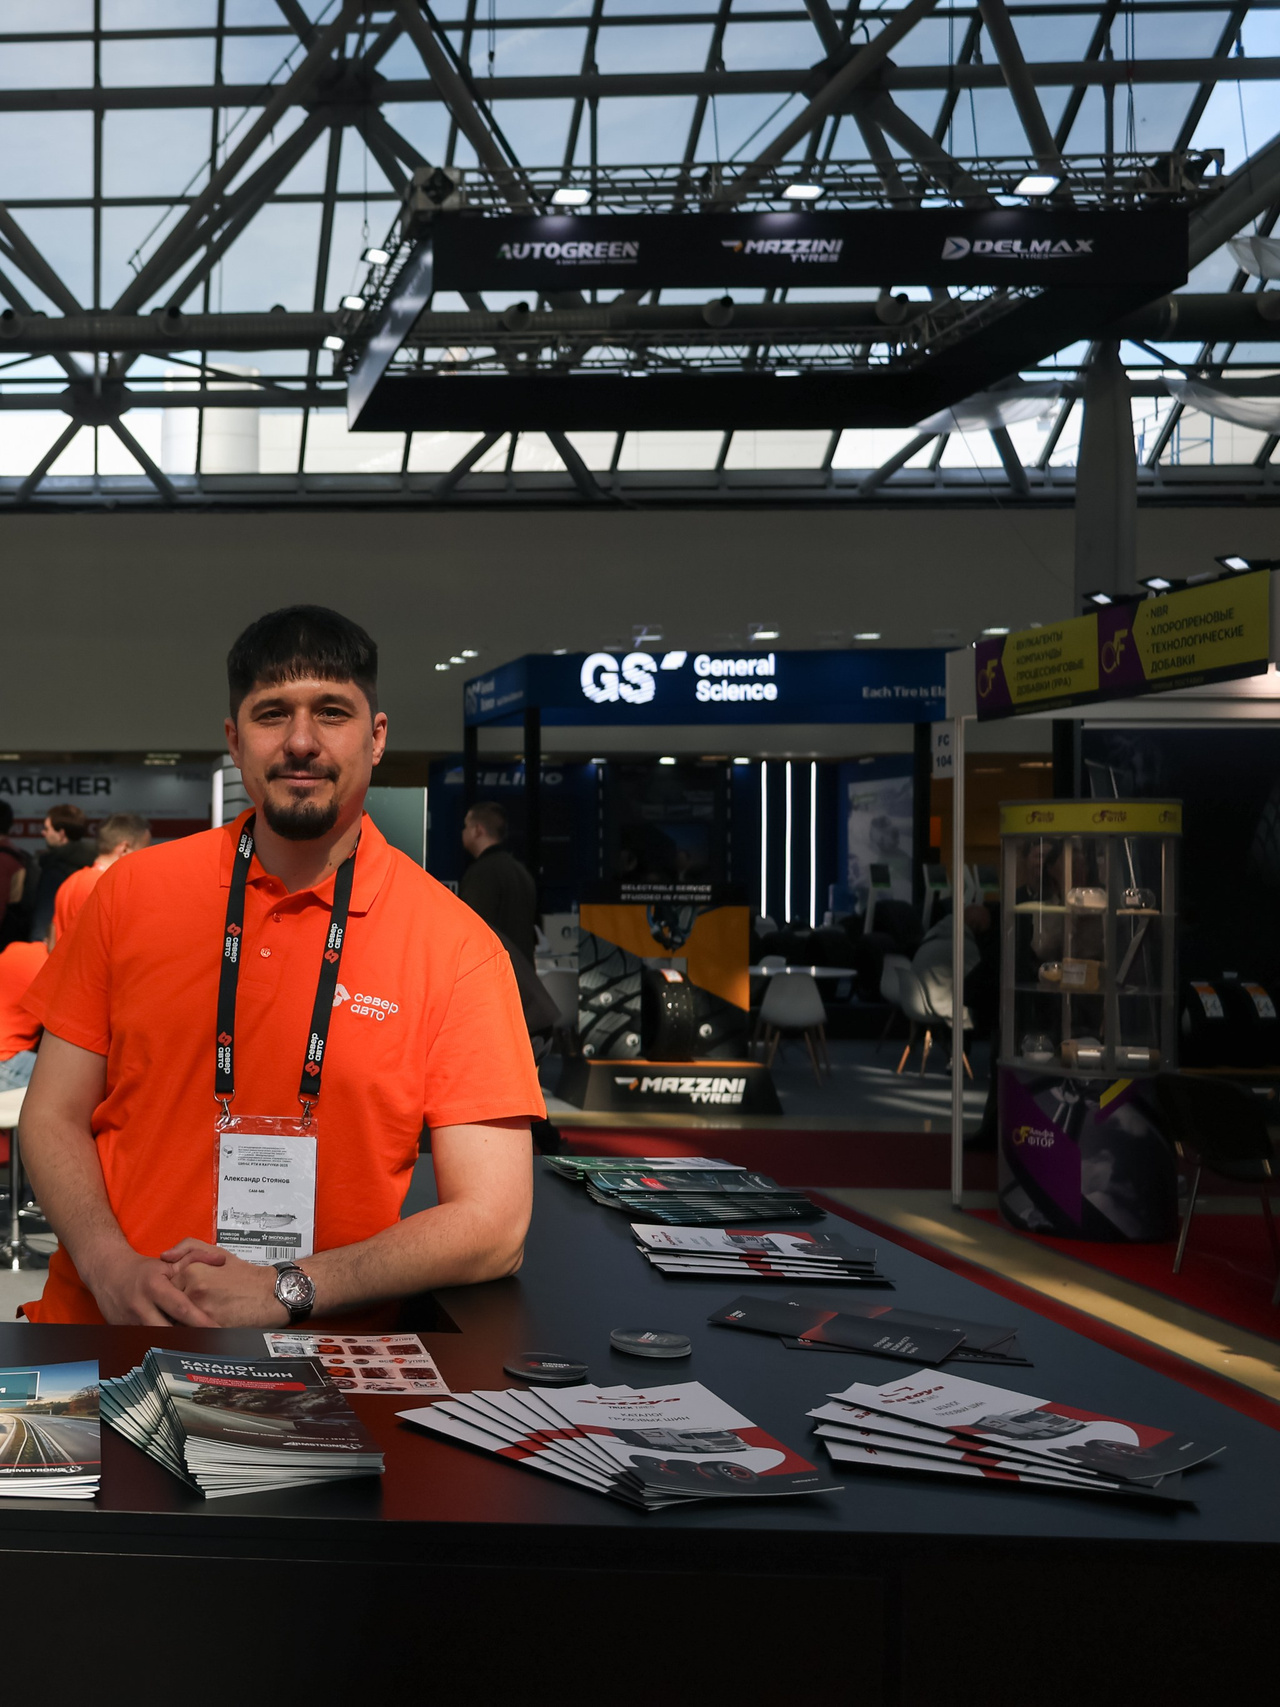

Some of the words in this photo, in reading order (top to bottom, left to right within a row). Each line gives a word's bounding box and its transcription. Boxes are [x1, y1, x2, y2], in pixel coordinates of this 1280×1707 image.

[497, 241, 639, 259] AUTOGREEN
[744, 239, 844, 255] MAZZINI
[972, 239, 1094, 254] DELMAX
[790, 253, 840, 263] TYRES
[1150, 604, 1169, 618] NBR
[1150, 607, 1235, 637] ХЛОРОПРЕНОВЫЕ
[1151, 625, 1245, 654] ТЕХНОЛОГИЧЕСКИЕ
[693, 652, 776, 678] General
[1151, 654, 1196, 674] ДОБАВКИ
[581, 652, 658, 705] GS
[696, 679, 778, 703] Science
[862, 685, 892, 699] Each
[937, 734, 950, 747] FC
[936, 755, 953, 768] 104
[327, 923, 338, 949] север
[334, 928, 343, 949] авто
[224, 936, 232, 957] авто
[230, 937, 239, 963] север
[350, 1003, 385, 1021] авто
[354, 993, 399, 1015] север
[308, 1032, 318, 1060] север
[315, 1038, 324, 1061] авто
[640, 1077, 746, 1094] MAZZINI
[690, 1092, 744, 1104] TYRES
[1027, 1137, 1055, 1148] ФТОР
[224, 1174, 261, 1184] Александр
[262, 1176, 291, 1185] Стоянов
[180, 1360, 256, 1372] КАТАЛОГ
[182, 1365, 249, 1376] ЛЕТНИХ
[880, 1386, 945, 1404] Satoya
